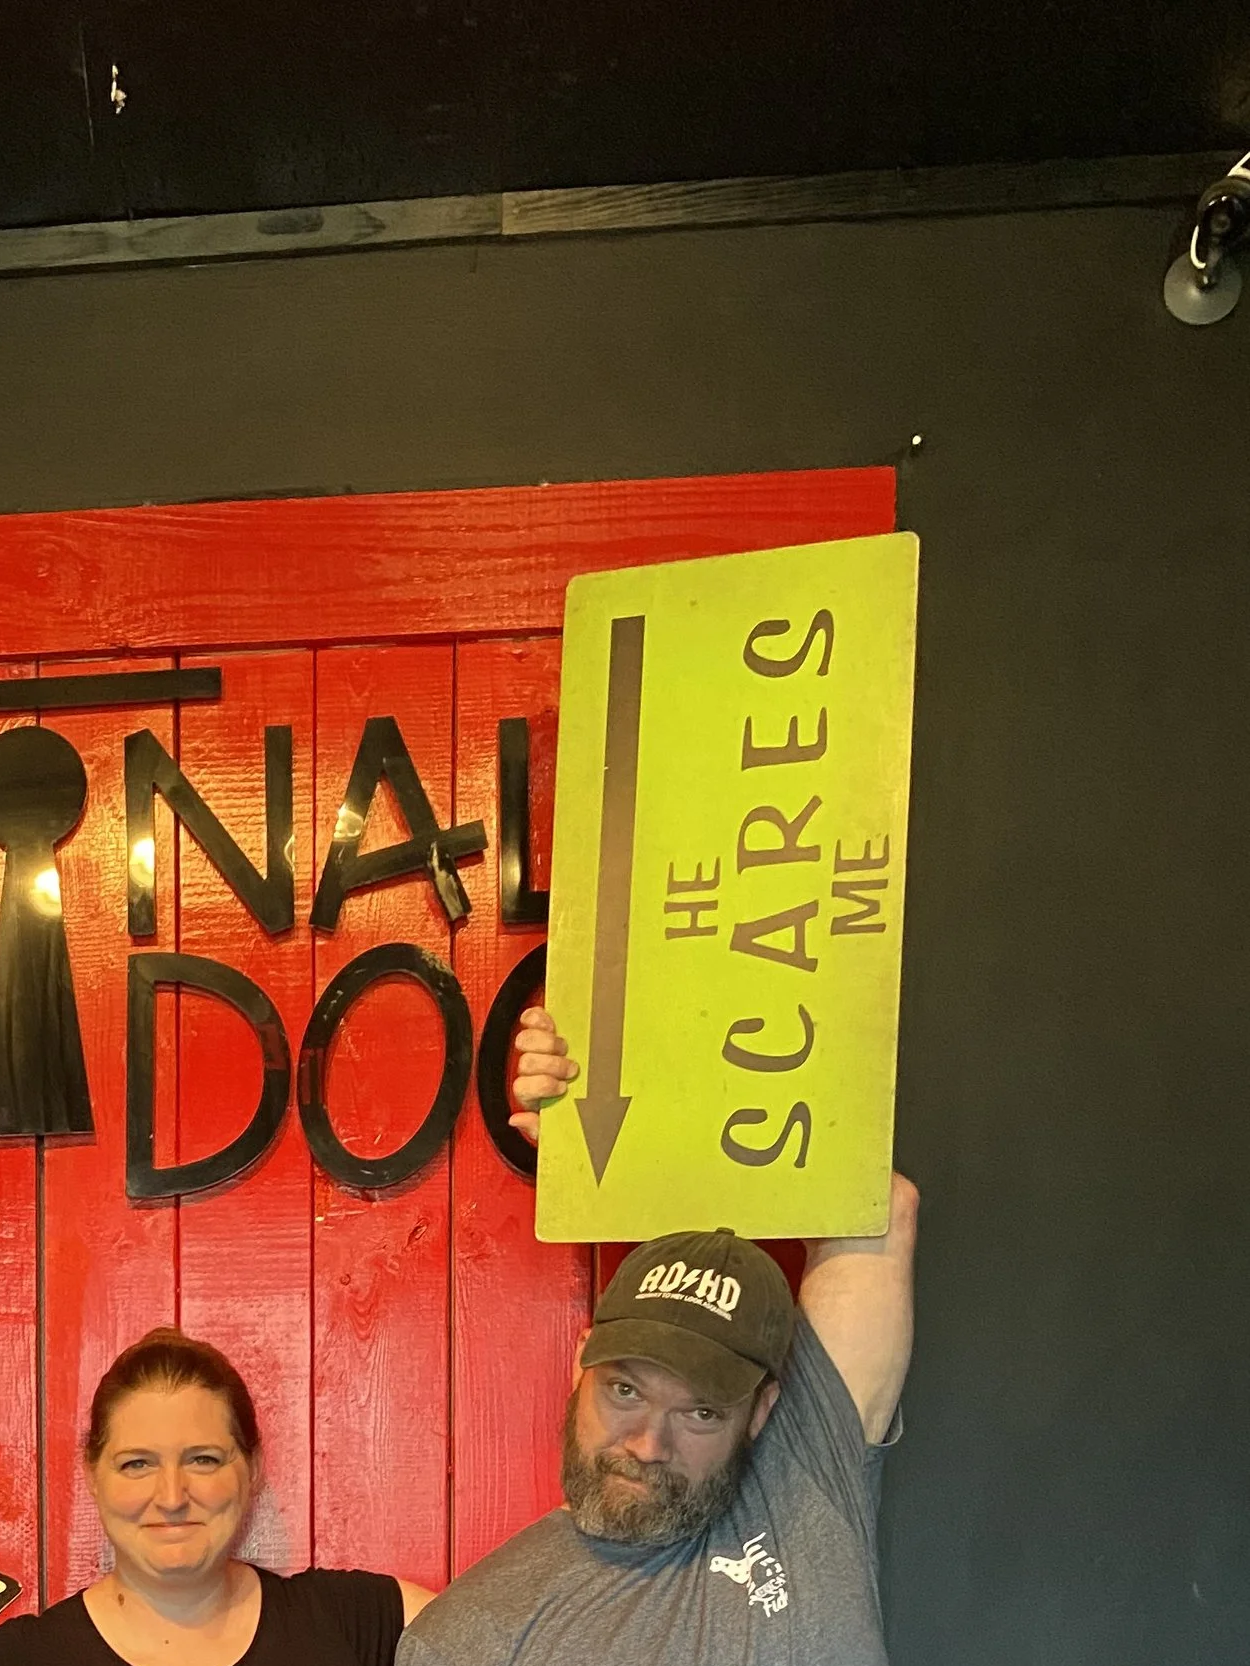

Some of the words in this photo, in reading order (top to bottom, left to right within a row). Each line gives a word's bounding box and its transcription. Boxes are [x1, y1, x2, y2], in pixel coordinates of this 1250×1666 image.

[664, 855, 721, 940] HE
[719, 607, 836, 1169] SCARES
[829, 832, 891, 936] ME
